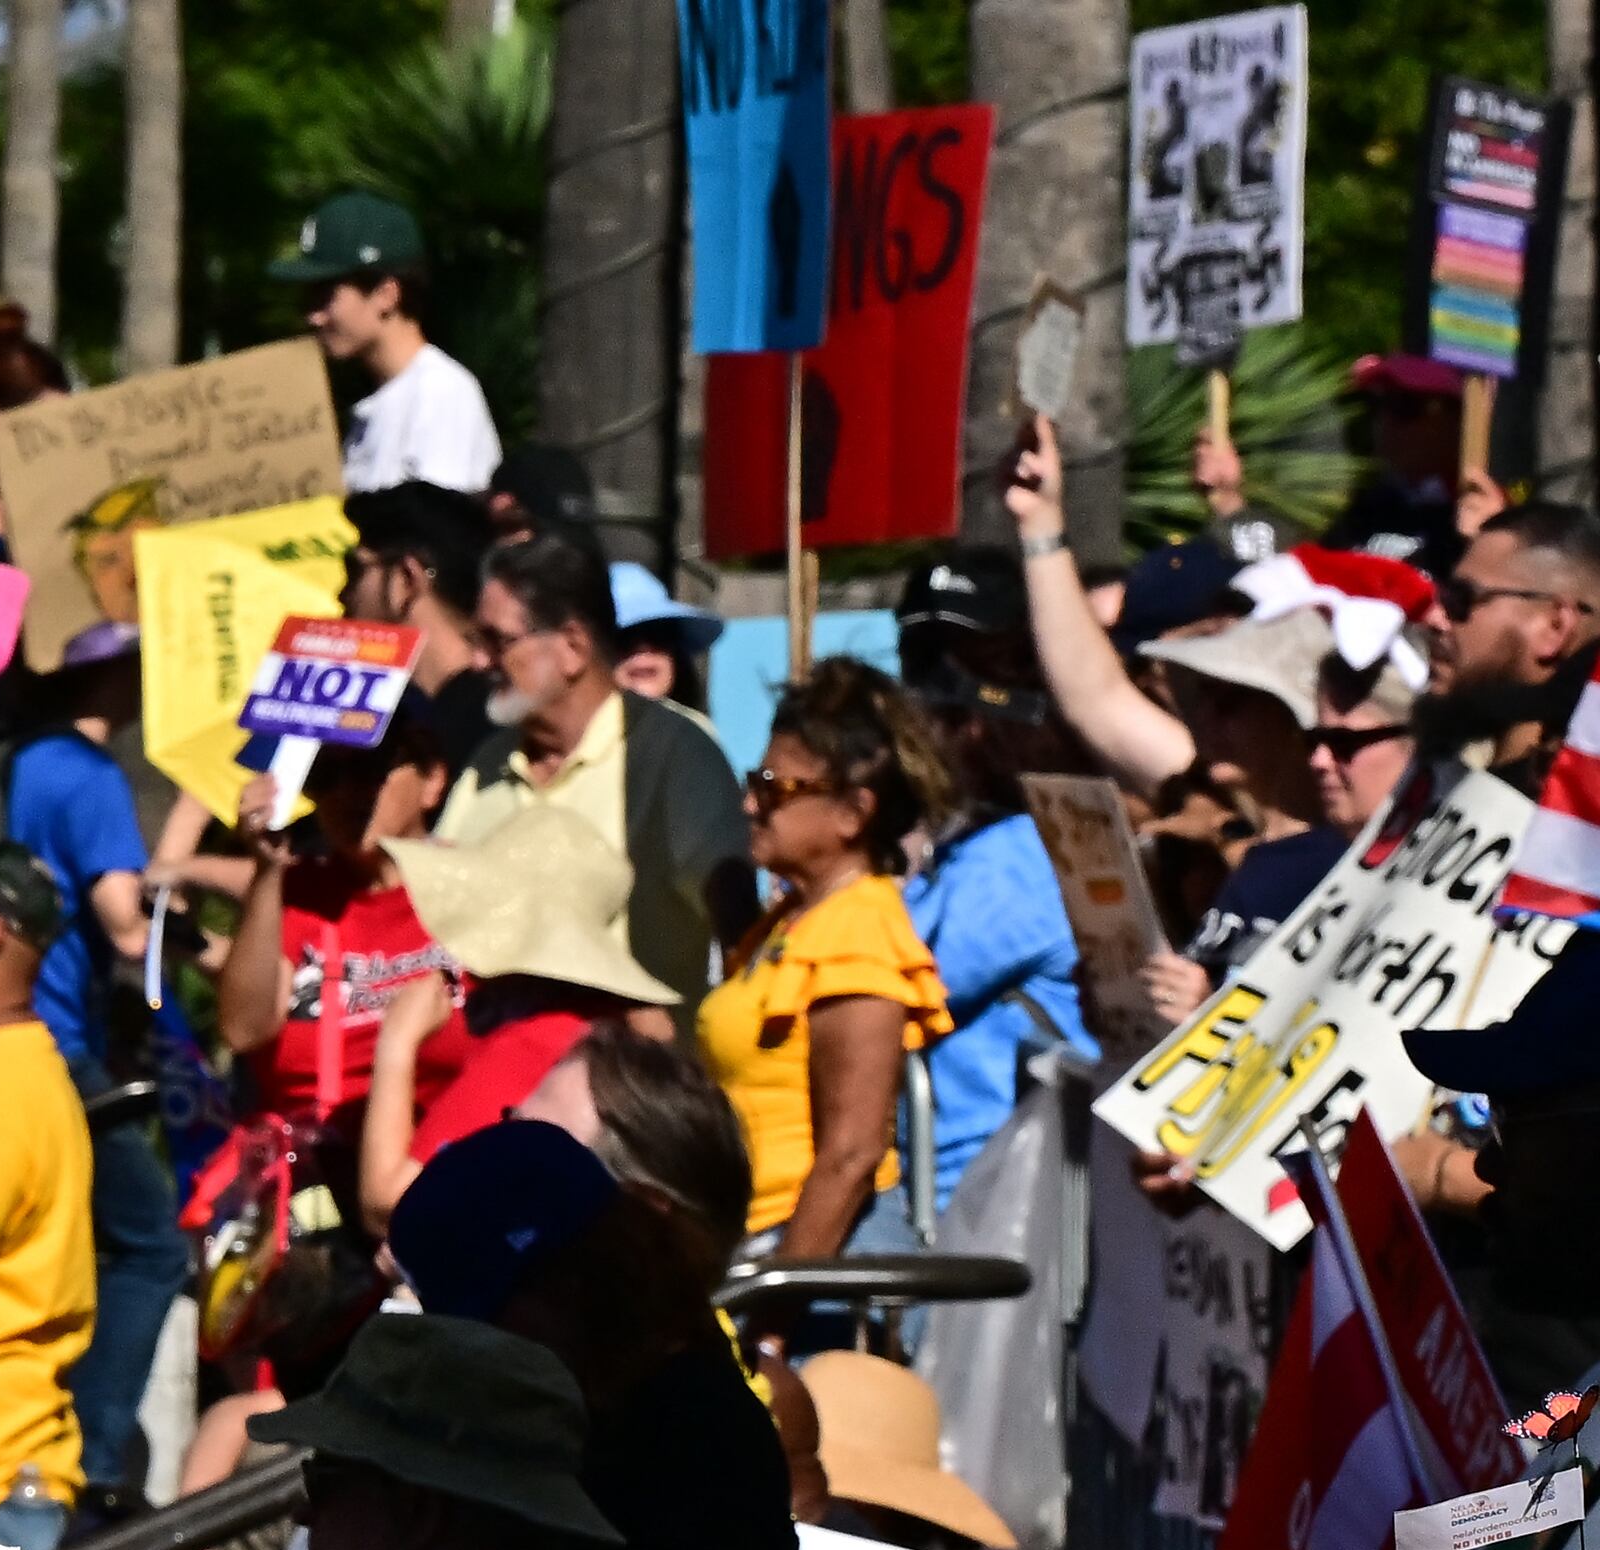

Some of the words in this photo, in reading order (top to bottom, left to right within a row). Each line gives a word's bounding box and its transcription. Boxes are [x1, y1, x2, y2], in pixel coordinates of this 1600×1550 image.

[272, 658, 388, 711] NOT
[1450, 1502, 1474, 1513] NELA
[1450, 1505, 1493, 1519] ALLIANCE
[1451, 1507, 1509, 1527] DEMOCRACY
[1452, 1508, 1558, 1540] nelafordemocracy.org
[1453, 1541, 1470, 1550] NO
[1474, 1530, 1513, 1545] KINGS
